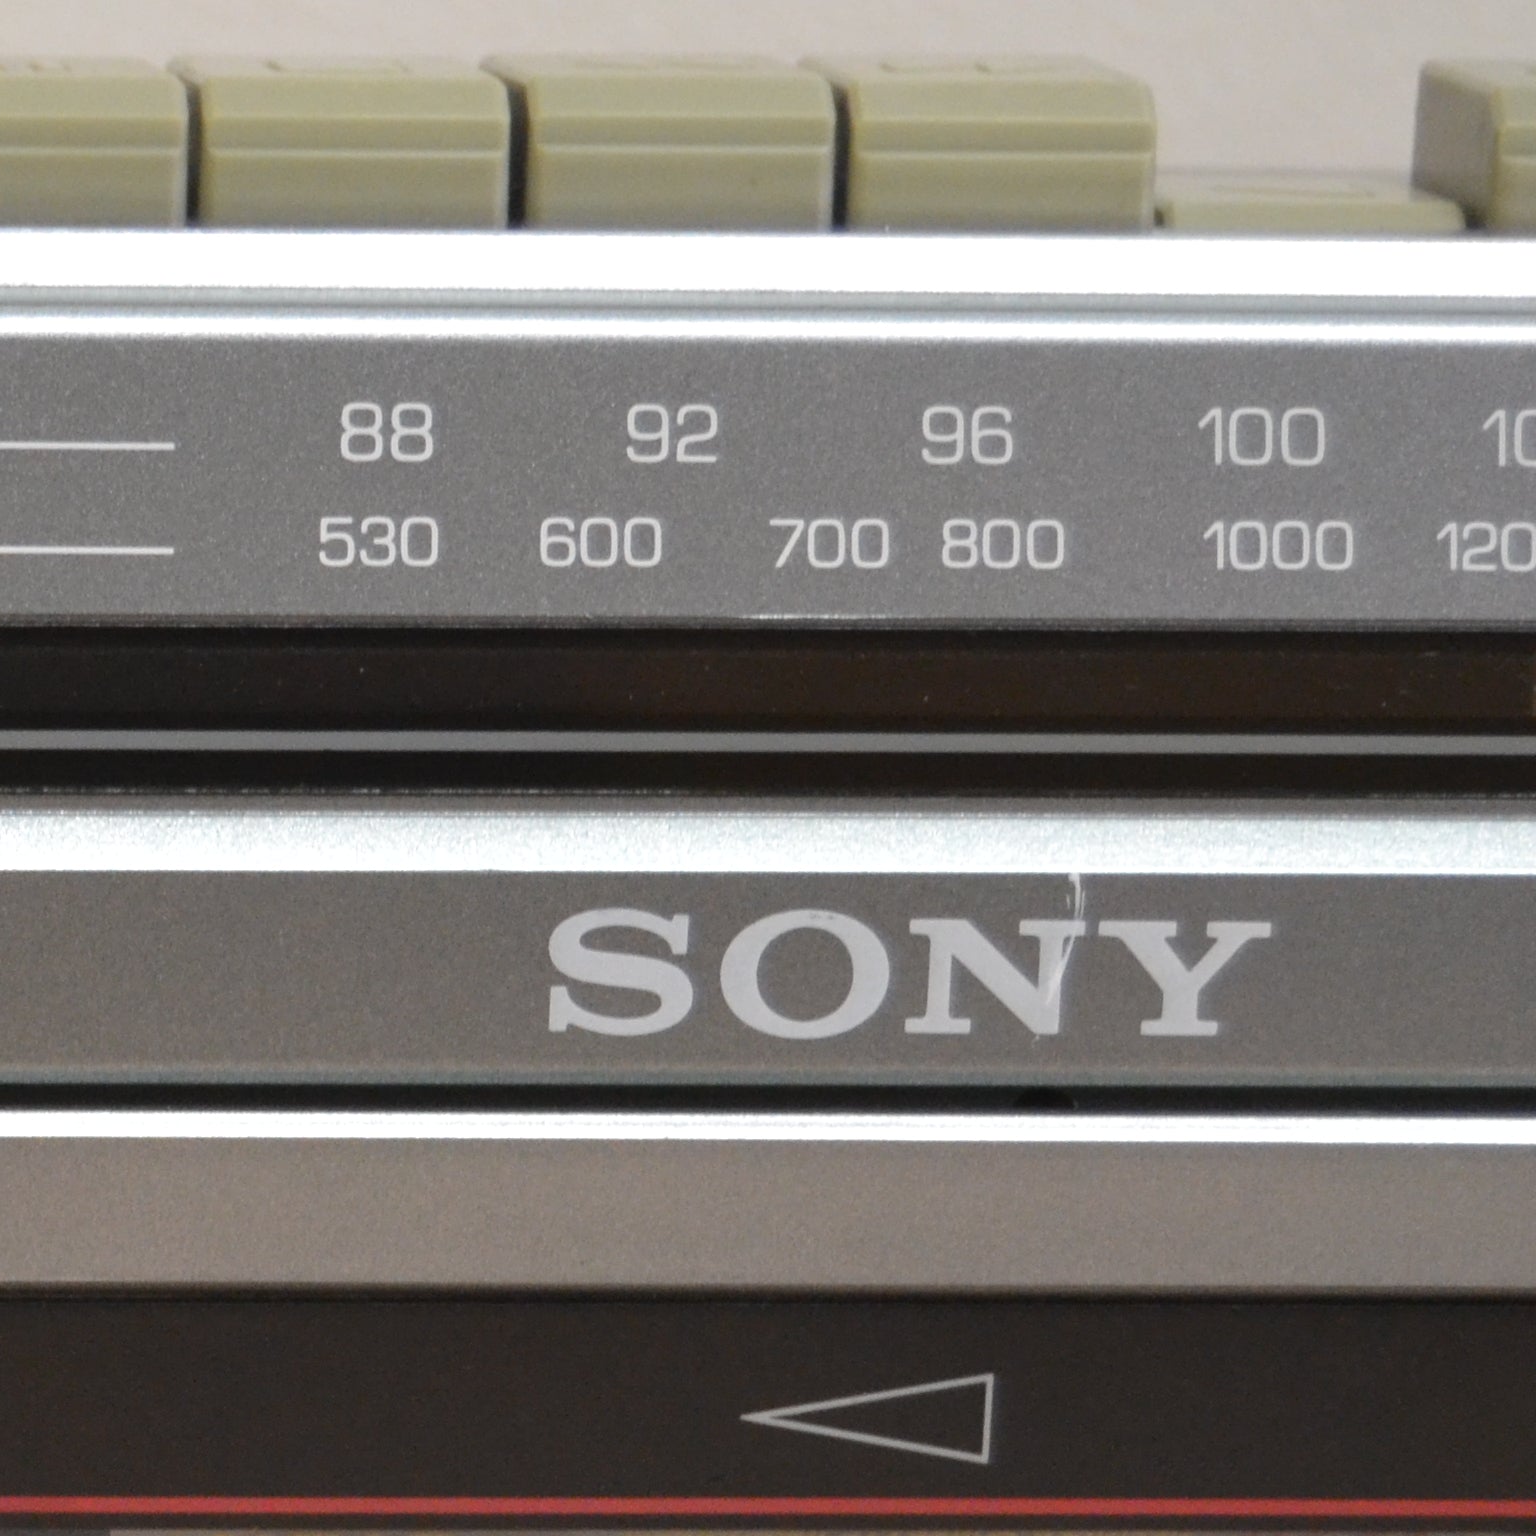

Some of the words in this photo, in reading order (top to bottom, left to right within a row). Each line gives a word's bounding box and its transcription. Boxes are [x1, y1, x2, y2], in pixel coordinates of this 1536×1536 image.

[340, 401, 434, 462] 88
[626, 403, 719, 463] 92
[921, 405, 1014, 465] 96
[1198, 406, 1326, 467] 100
[318, 515, 439, 567] 530
[539, 516, 663, 568] 600
[769, 518, 890, 569] 700
[941, 518, 1065, 570] 800
[1203, 520, 1354, 571] 1000
[548, 906, 1272, 1040] SONY
